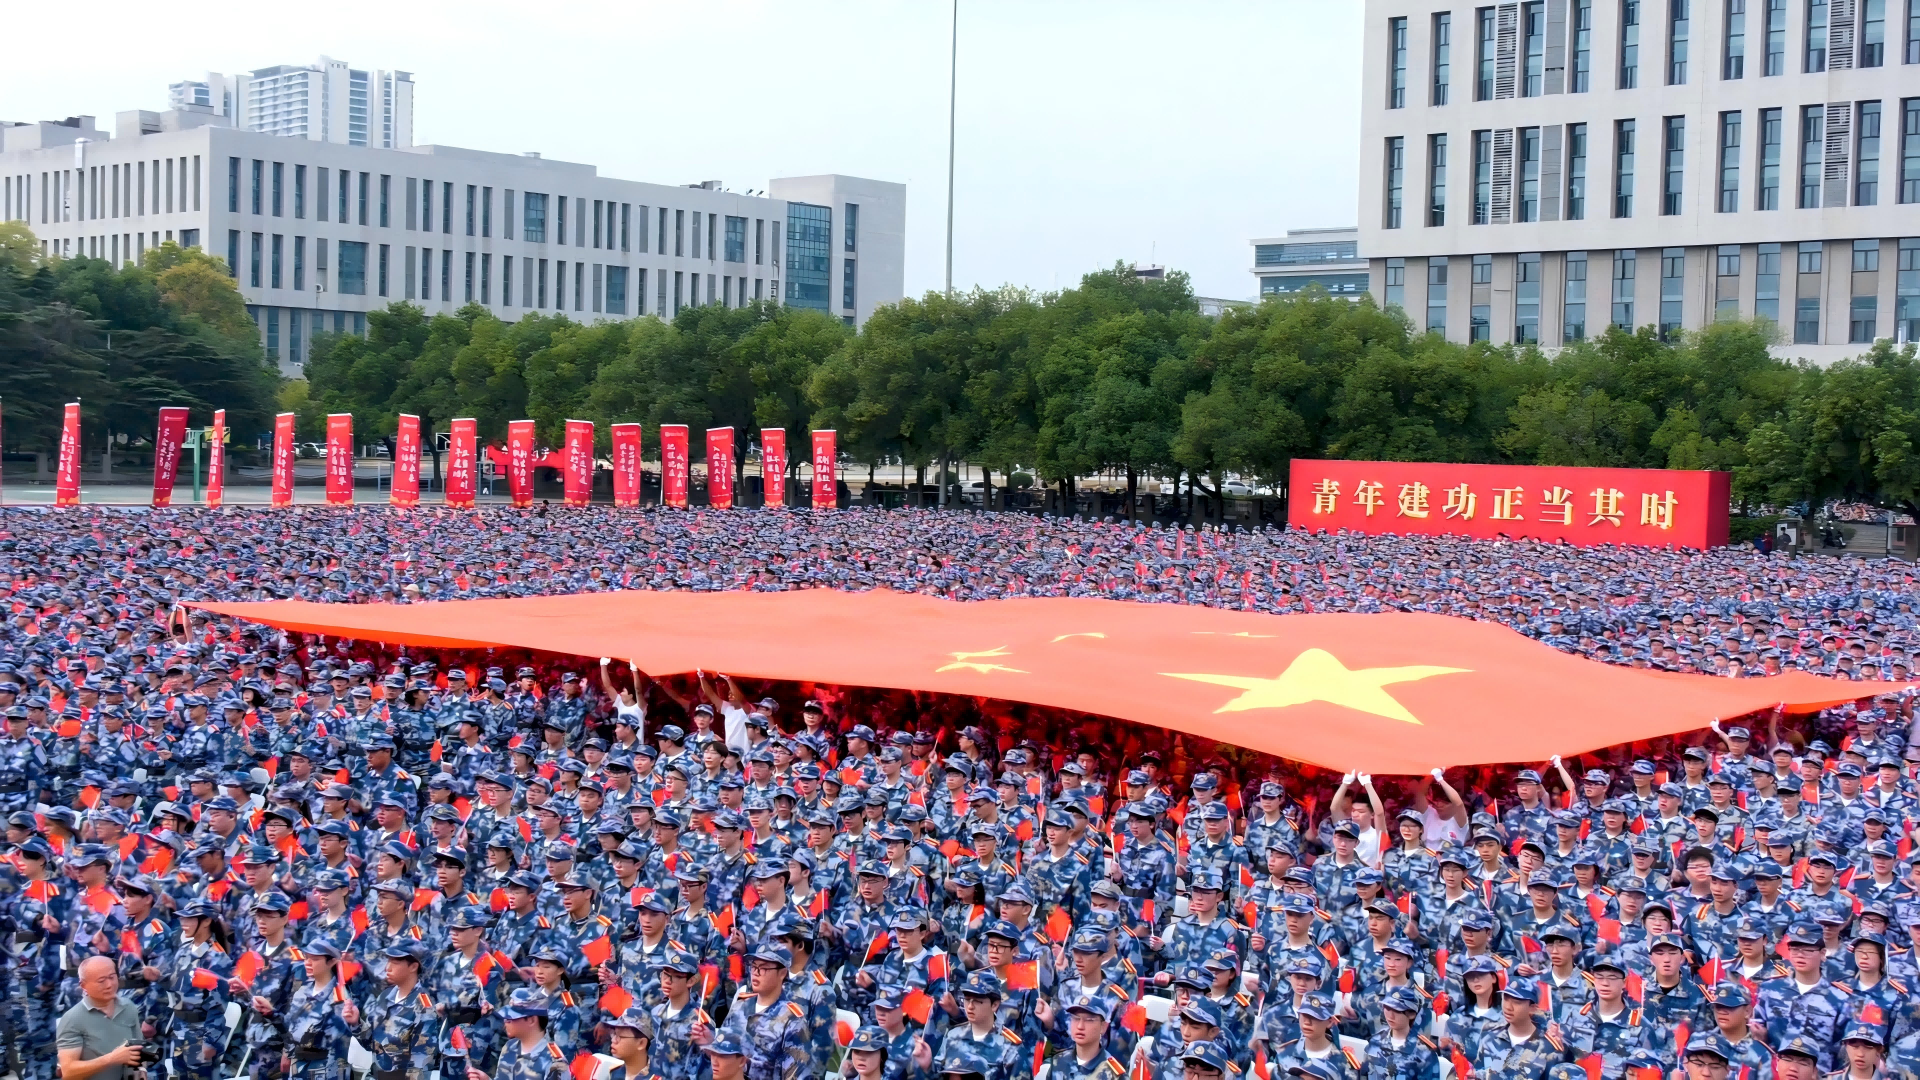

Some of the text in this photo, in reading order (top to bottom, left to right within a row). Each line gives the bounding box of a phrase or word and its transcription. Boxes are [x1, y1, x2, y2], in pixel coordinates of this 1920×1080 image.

[1311, 478, 1679, 530] 青年建功正当其时
